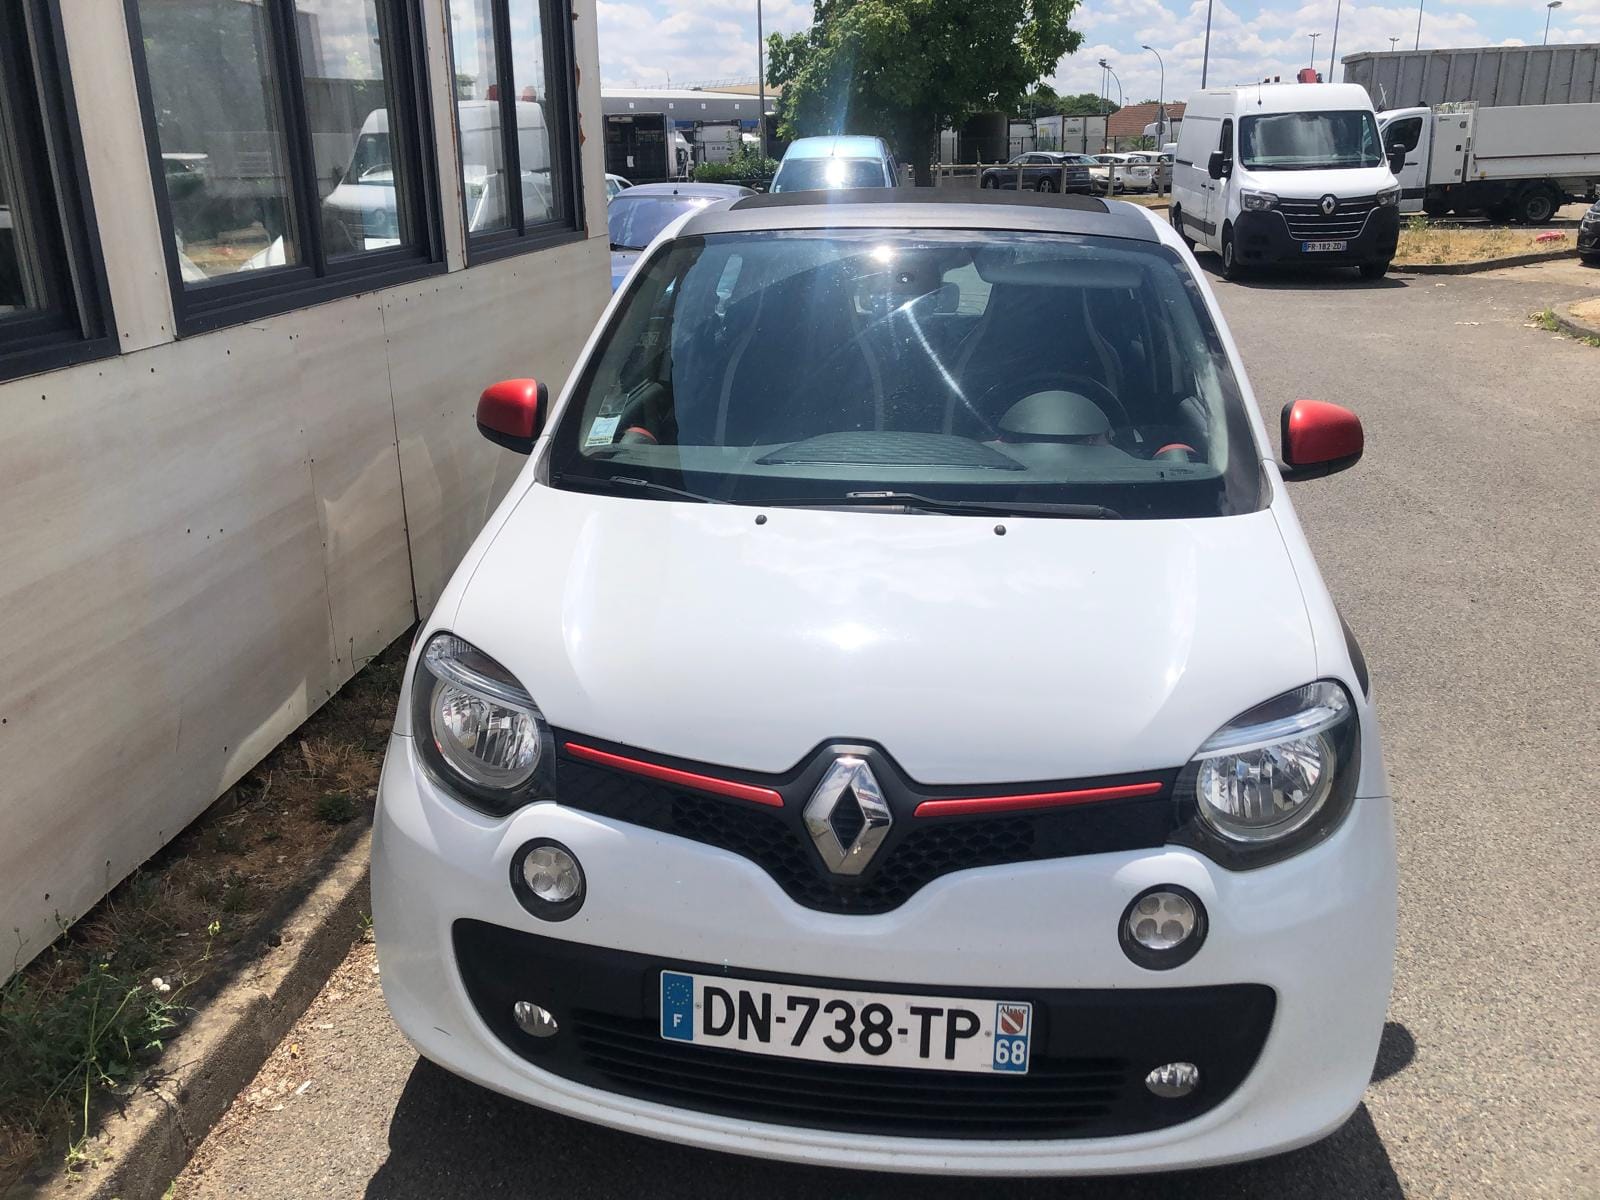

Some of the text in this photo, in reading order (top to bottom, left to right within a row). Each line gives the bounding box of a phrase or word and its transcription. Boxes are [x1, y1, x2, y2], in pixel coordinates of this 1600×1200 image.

[1000, 1005, 1027, 1014] Alsace
[673, 1013, 683, 1028] F
[703, 985, 980, 1060] DN-738-TP
[995, 1038, 1025, 1065] 68
